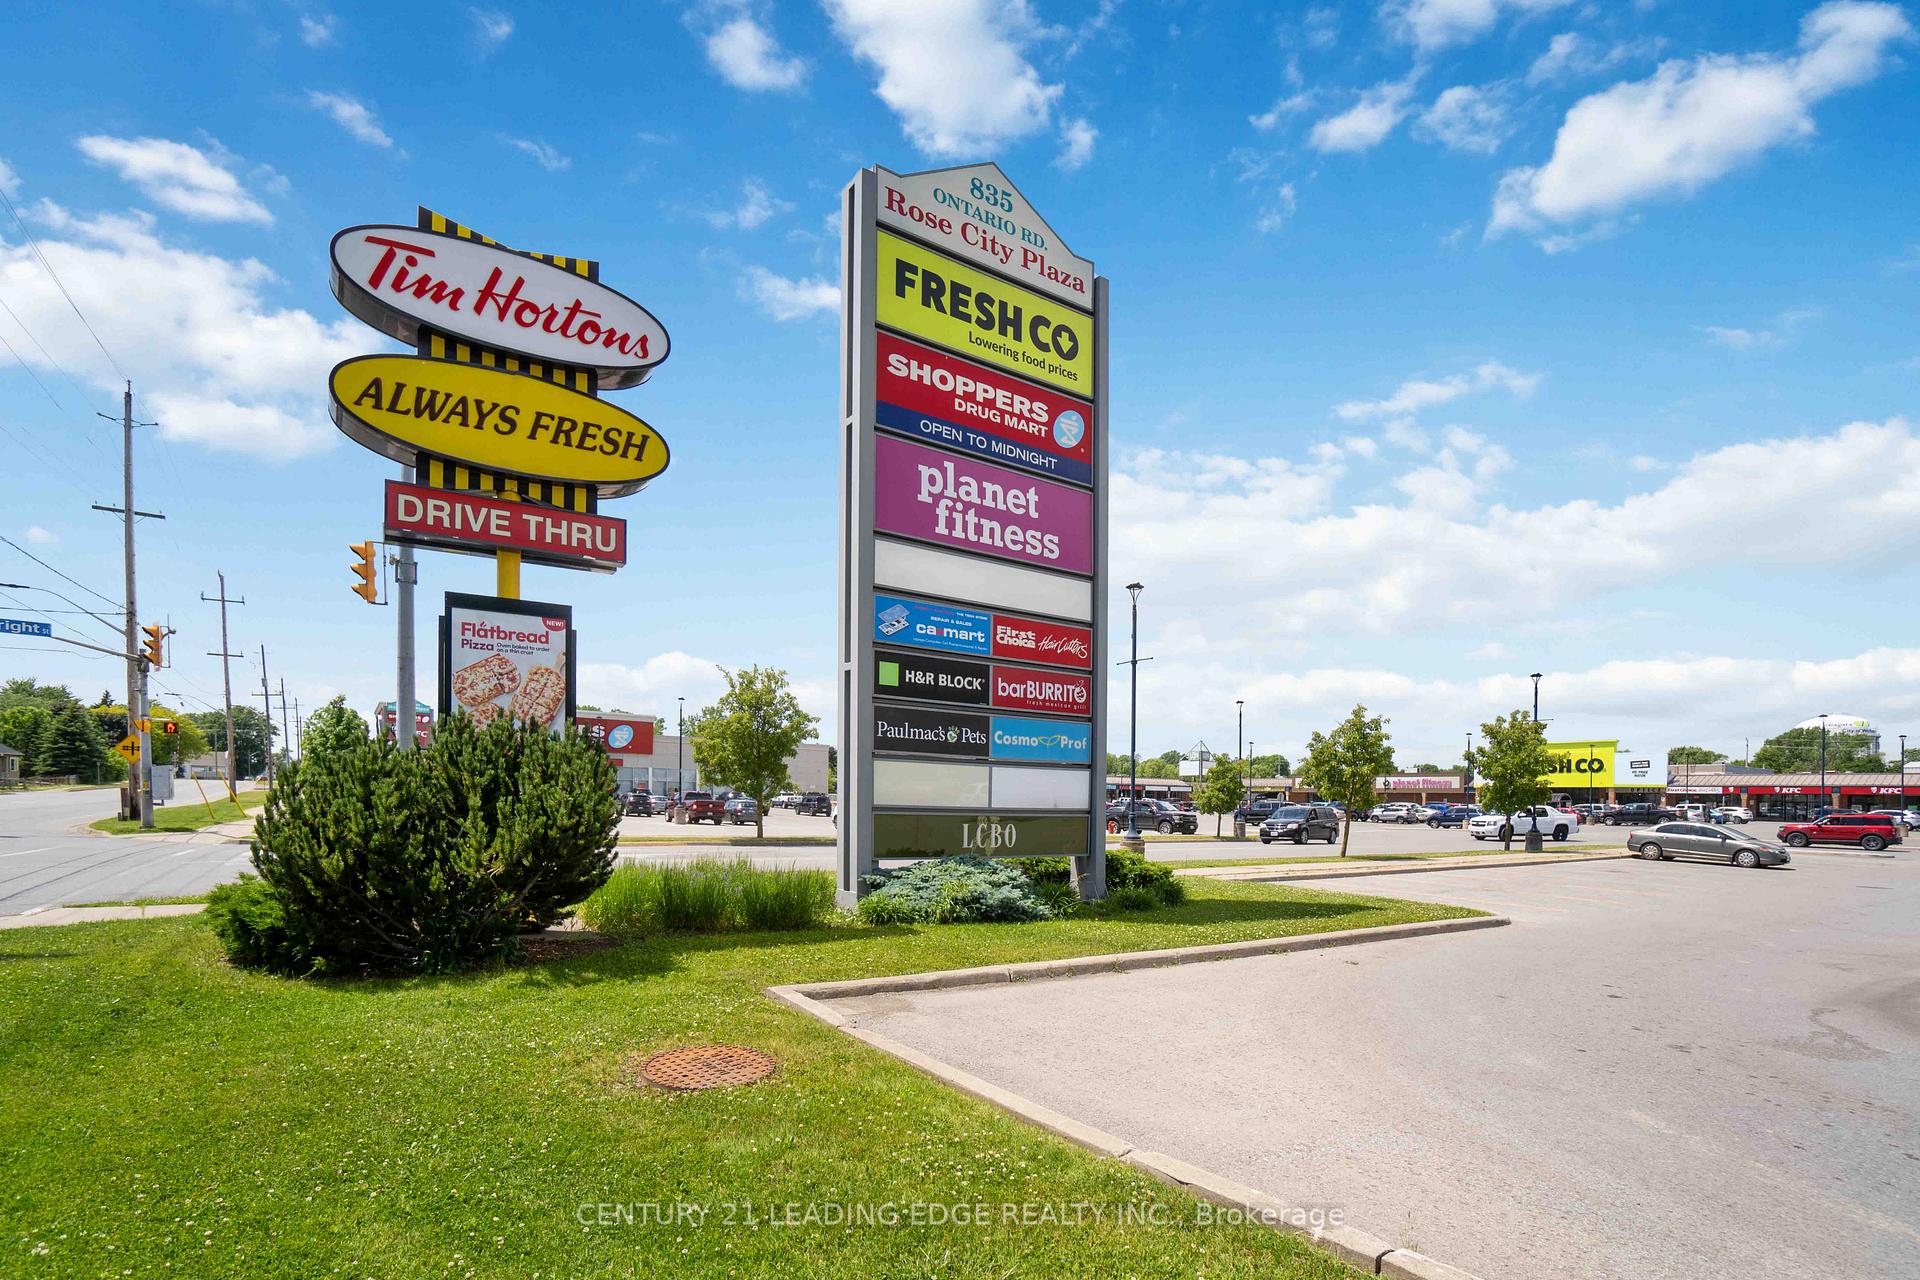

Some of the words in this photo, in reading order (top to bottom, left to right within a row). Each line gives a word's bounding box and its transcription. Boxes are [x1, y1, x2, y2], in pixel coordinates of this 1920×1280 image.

[970, 177, 1013, 213] 835
[933, 187, 1016, 236] ONTARIO
[1021, 227, 1048, 250] RD.
[884, 186, 953, 235] Rose
[961, 222, 1014, 264] City
[1020, 246, 1085, 294] Plaza
[364, 236, 466, 312] Tim
[473, 266, 650, 360] Hortons
[968, 331, 1019, 361] Lowering
[1022, 350, 1046, 370] food
[1048, 363, 1078, 382] prices
[886, 353, 1049, 423] SHOPPERS
[354, 377, 521, 436] ALWAYS
[527, 411, 650, 462] FRESH
[954, 398, 1001, 424] DRUG
[1004, 416, 1049, 438] MART
[920, 419, 963, 442] OPEN
[966, 432, 987, 449] TO
[991, 440, 1058, 470] MIDNIGHT
[917, 461, 1039, 519] planet
[397, 493, 511, 538] DRIVE
[522, 513, 617, 553] THRU
[935, 499, 1060, 559] fitness
[546, 620, 564, 628] NEW!
[996, 625, 1036, 640] First
[996, 634, 1036, 649] Choice
[461, 638, 494, 651] Pizza
[905, 669, 934, 685] H&R
[938, 673, 983, 690] BLOCK
[1045, 700, 1071, 708] mexican
[876, 720, 946, 741] Paulmac's
[960, 727, 987, 744] Pets
[994, 730, 1039, 747] Cosmo
[1060, 735, 1087, 750] Prof
[962, 823, 1017, 849] LCBO
